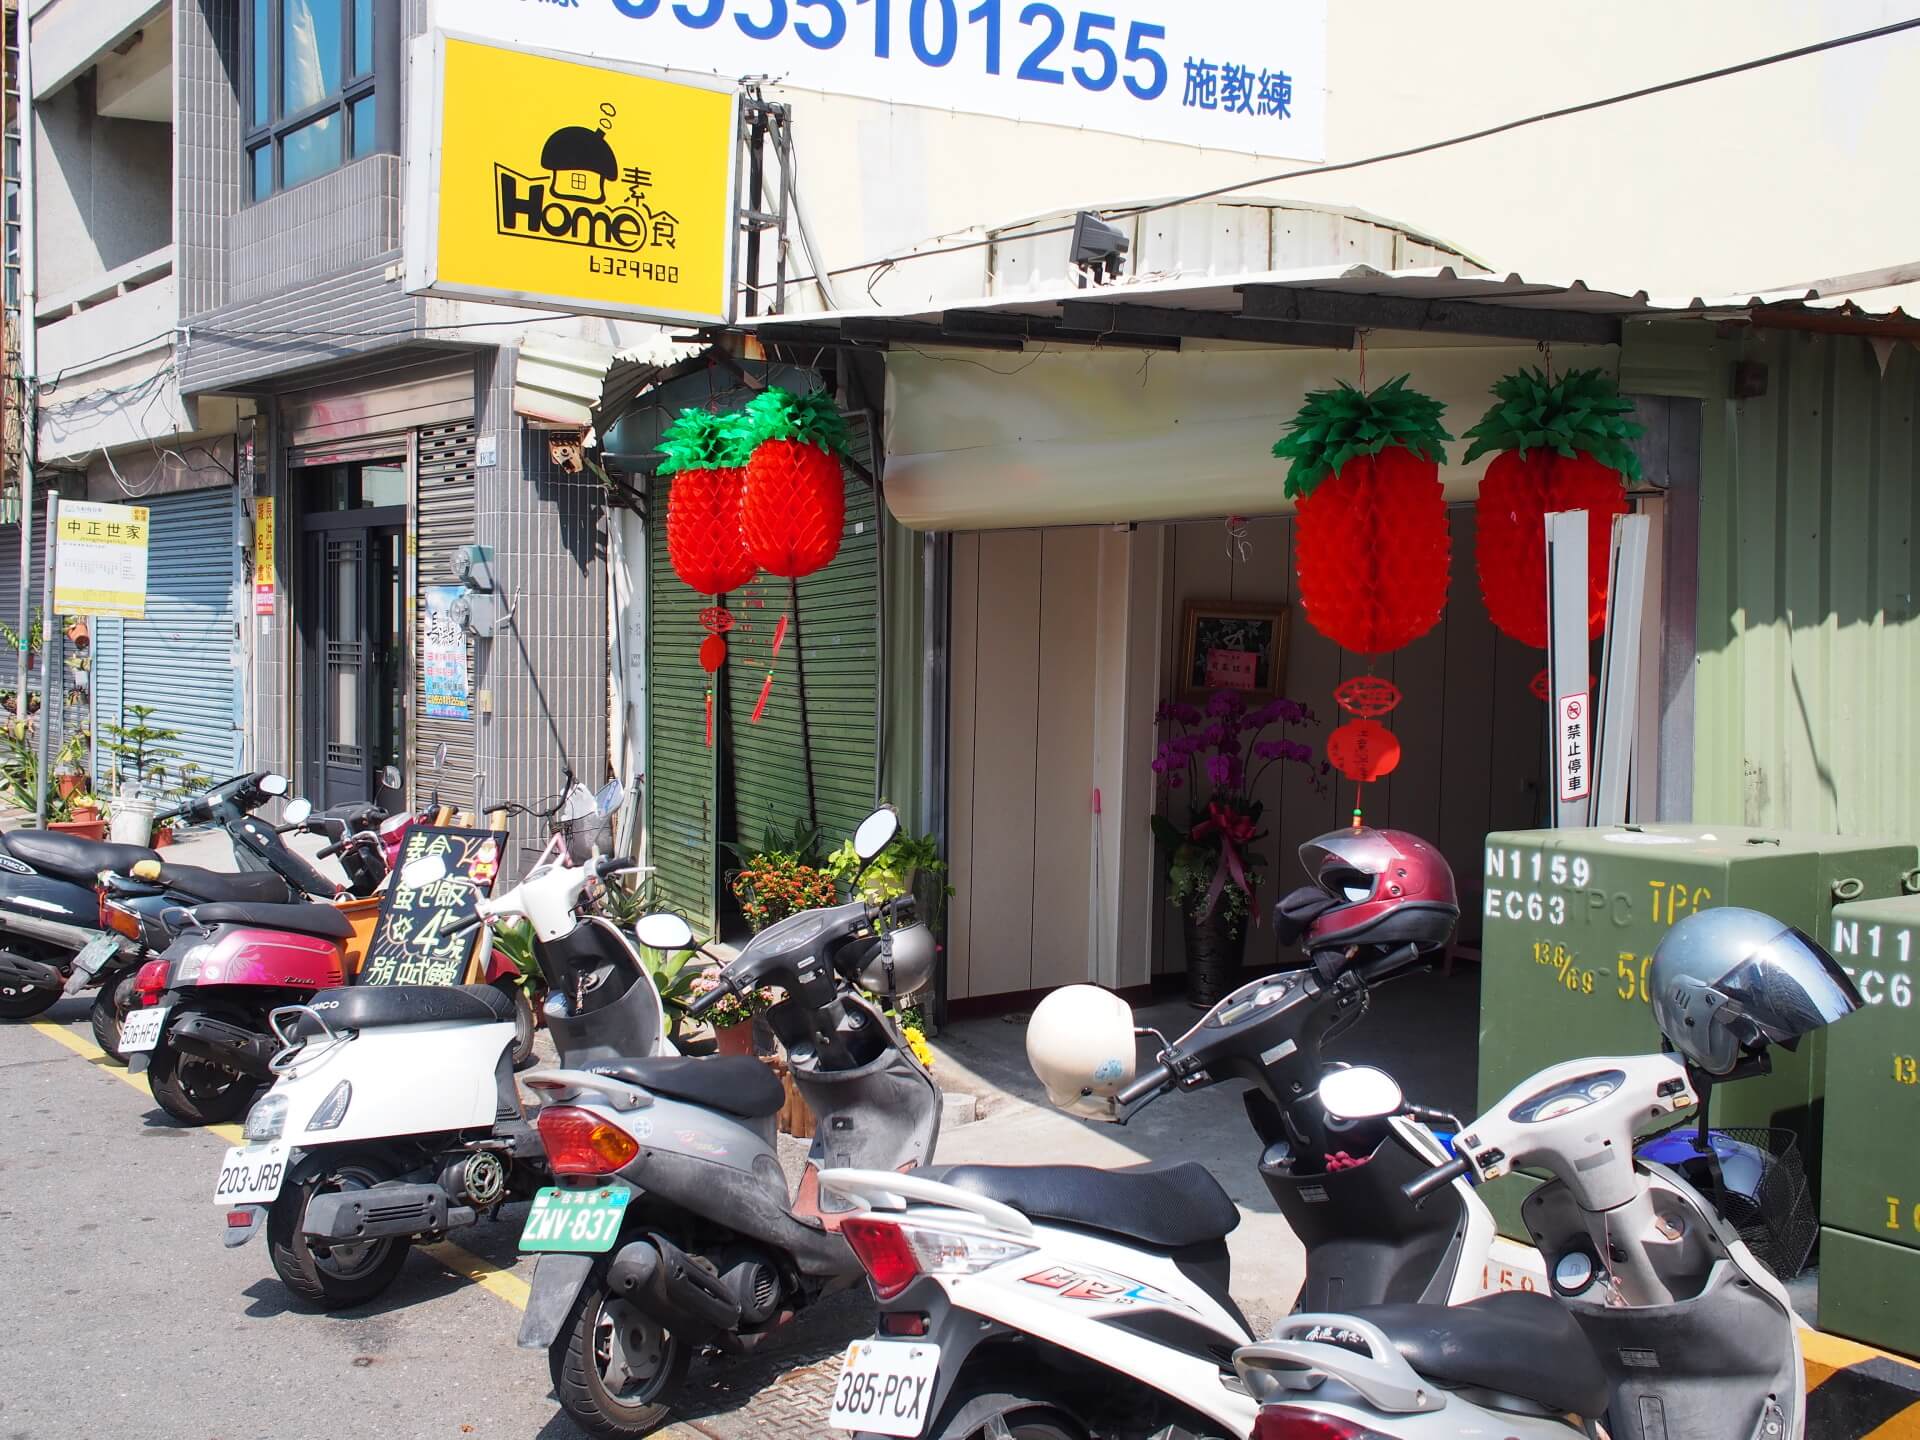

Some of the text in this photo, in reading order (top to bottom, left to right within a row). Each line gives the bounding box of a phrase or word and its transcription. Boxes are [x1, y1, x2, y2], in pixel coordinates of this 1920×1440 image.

[1182, 56, 1293, 121] 施教練
[501, 173, 641, 247] Home
[590, 255, 678, 283] 6329988
[67, 520, 141, 540] 中正世家
[1567, 724, 1582, 791] 禁止停車
[1485, 847, 1590, 888] N1159
[1485, 888, 1565, 925] EC63
